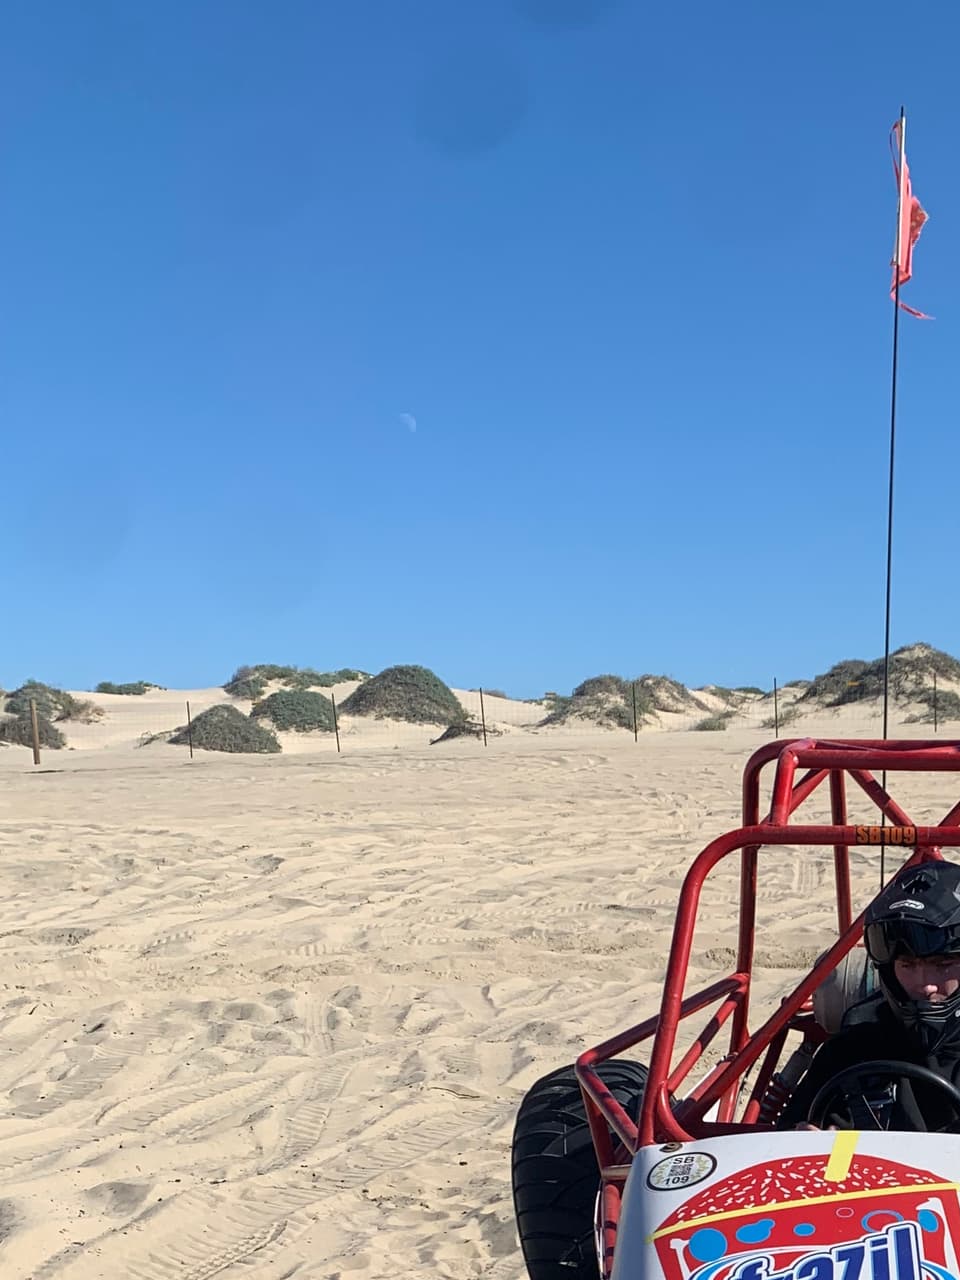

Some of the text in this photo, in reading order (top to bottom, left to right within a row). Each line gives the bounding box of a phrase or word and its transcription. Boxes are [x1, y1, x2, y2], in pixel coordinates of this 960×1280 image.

[856, 826, 916, 844] SB109
[673, 1156, 695, 1164] SB
[664, 1176, 689, 1185] 109
